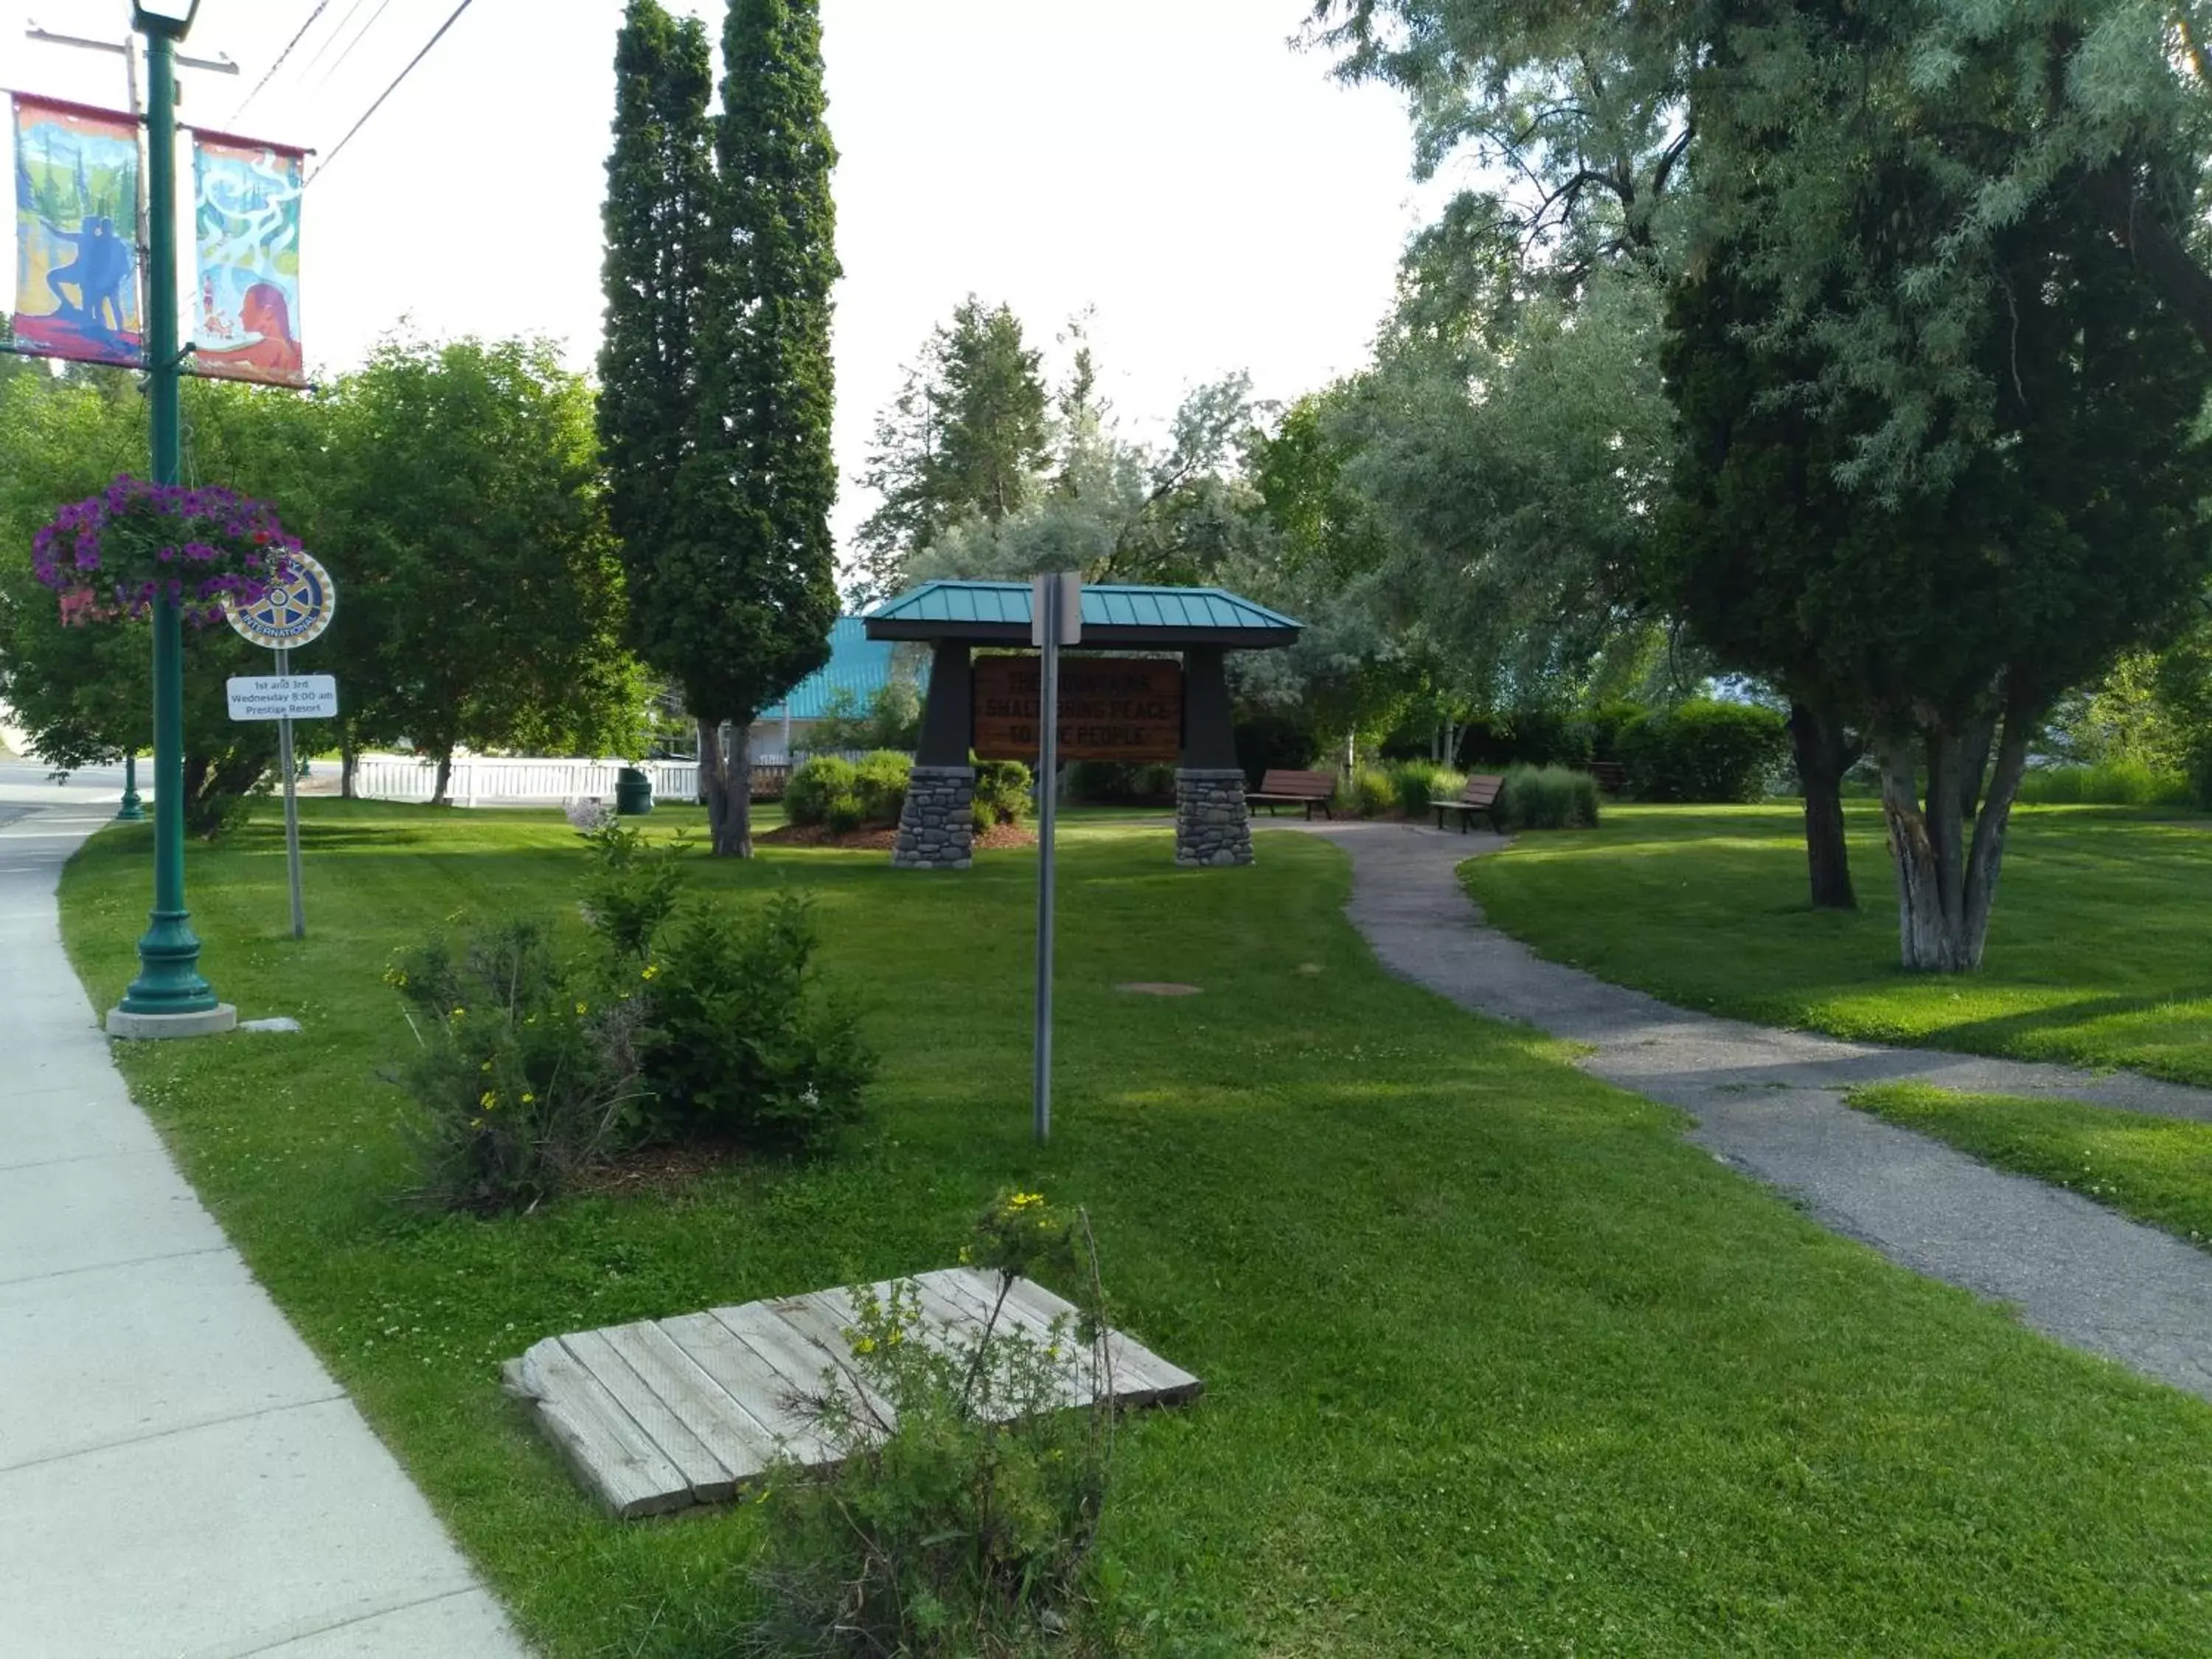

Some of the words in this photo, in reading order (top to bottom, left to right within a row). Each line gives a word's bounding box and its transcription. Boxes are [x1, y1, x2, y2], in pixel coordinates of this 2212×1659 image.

[242, 614, 317, 638] INTERNATIONAL
[255, 681, 268, 690] 1st
[271, 681, 290, 690] and
[293, 681, 309, 689] 3rd
[231, 694, 289, 703] Wednesday
[291, 691, 316, 700] 8:00
[246, 706, 288, 715] Prestige
[289, 704, 321, 713] Resort
[1077, 726, 1146, 745] PEOPLE
